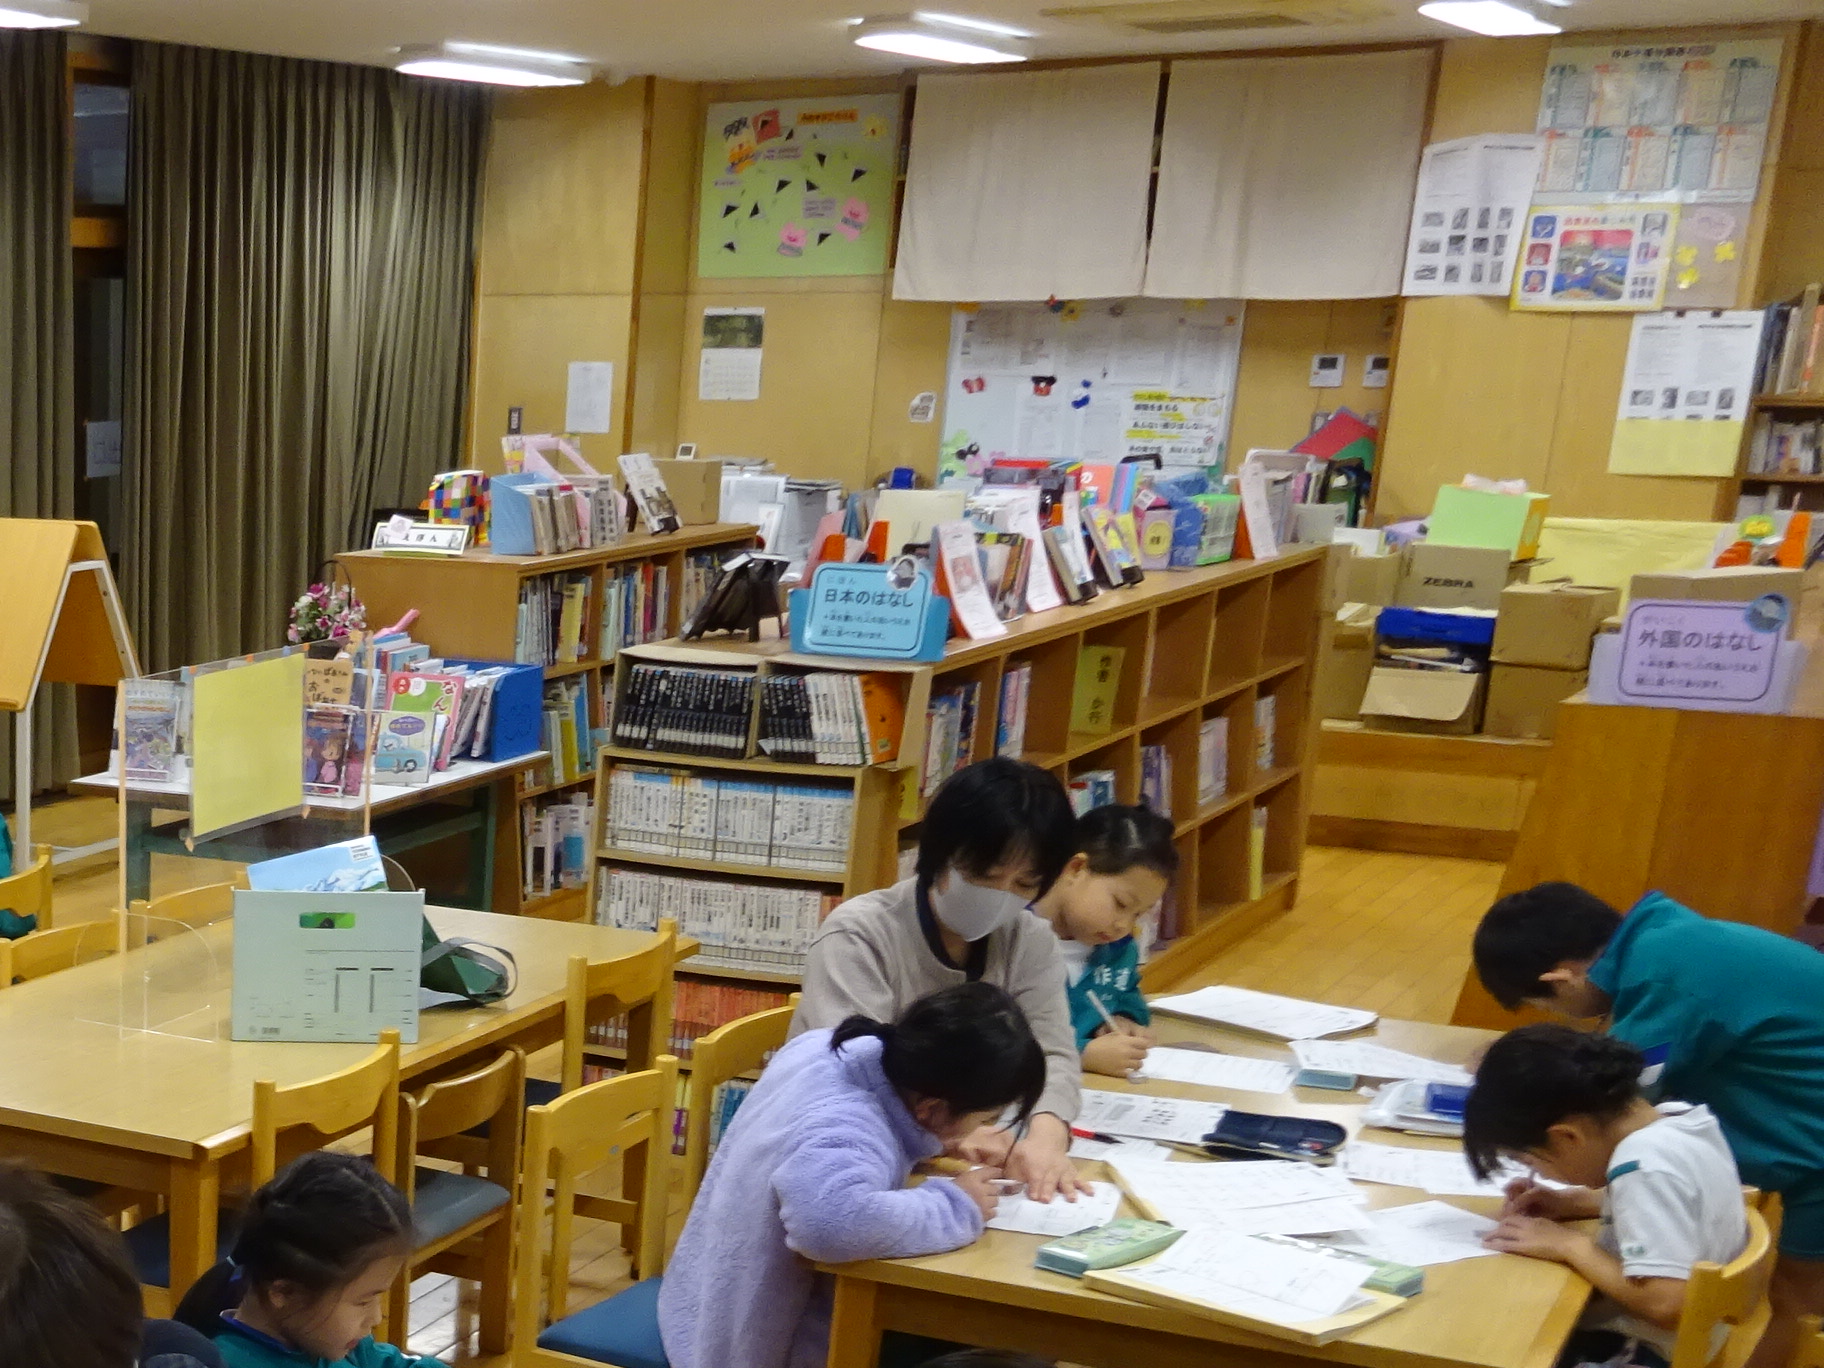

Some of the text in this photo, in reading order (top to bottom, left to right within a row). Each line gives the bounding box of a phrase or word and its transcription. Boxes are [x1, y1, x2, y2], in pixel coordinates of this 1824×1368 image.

[824, 588, 914, 608] 日本のはなし
[1638, 629, 1762, 651] 外国のはなし
